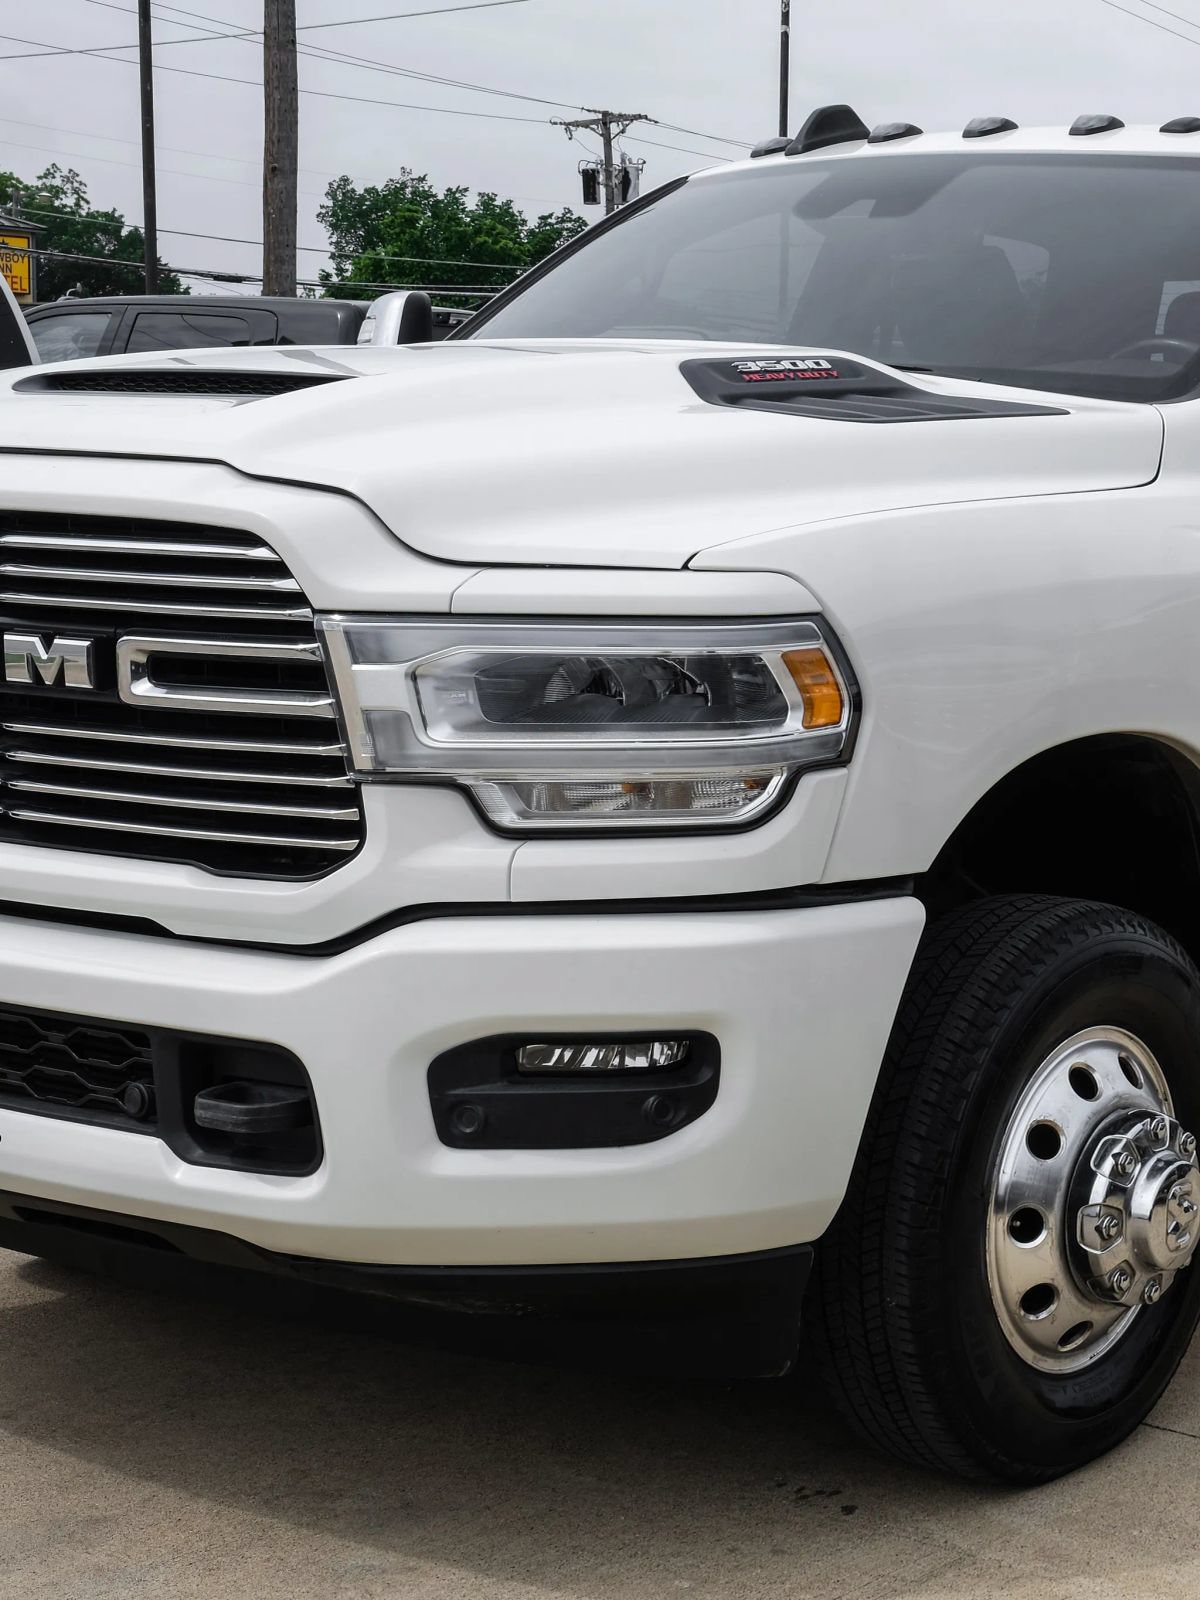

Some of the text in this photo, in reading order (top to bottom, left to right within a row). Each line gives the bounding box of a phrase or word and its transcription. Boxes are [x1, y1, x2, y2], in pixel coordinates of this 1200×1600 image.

[731, 359, 832, 372] 3500
[742, 370, 838, 381] HEAVY DUTY
